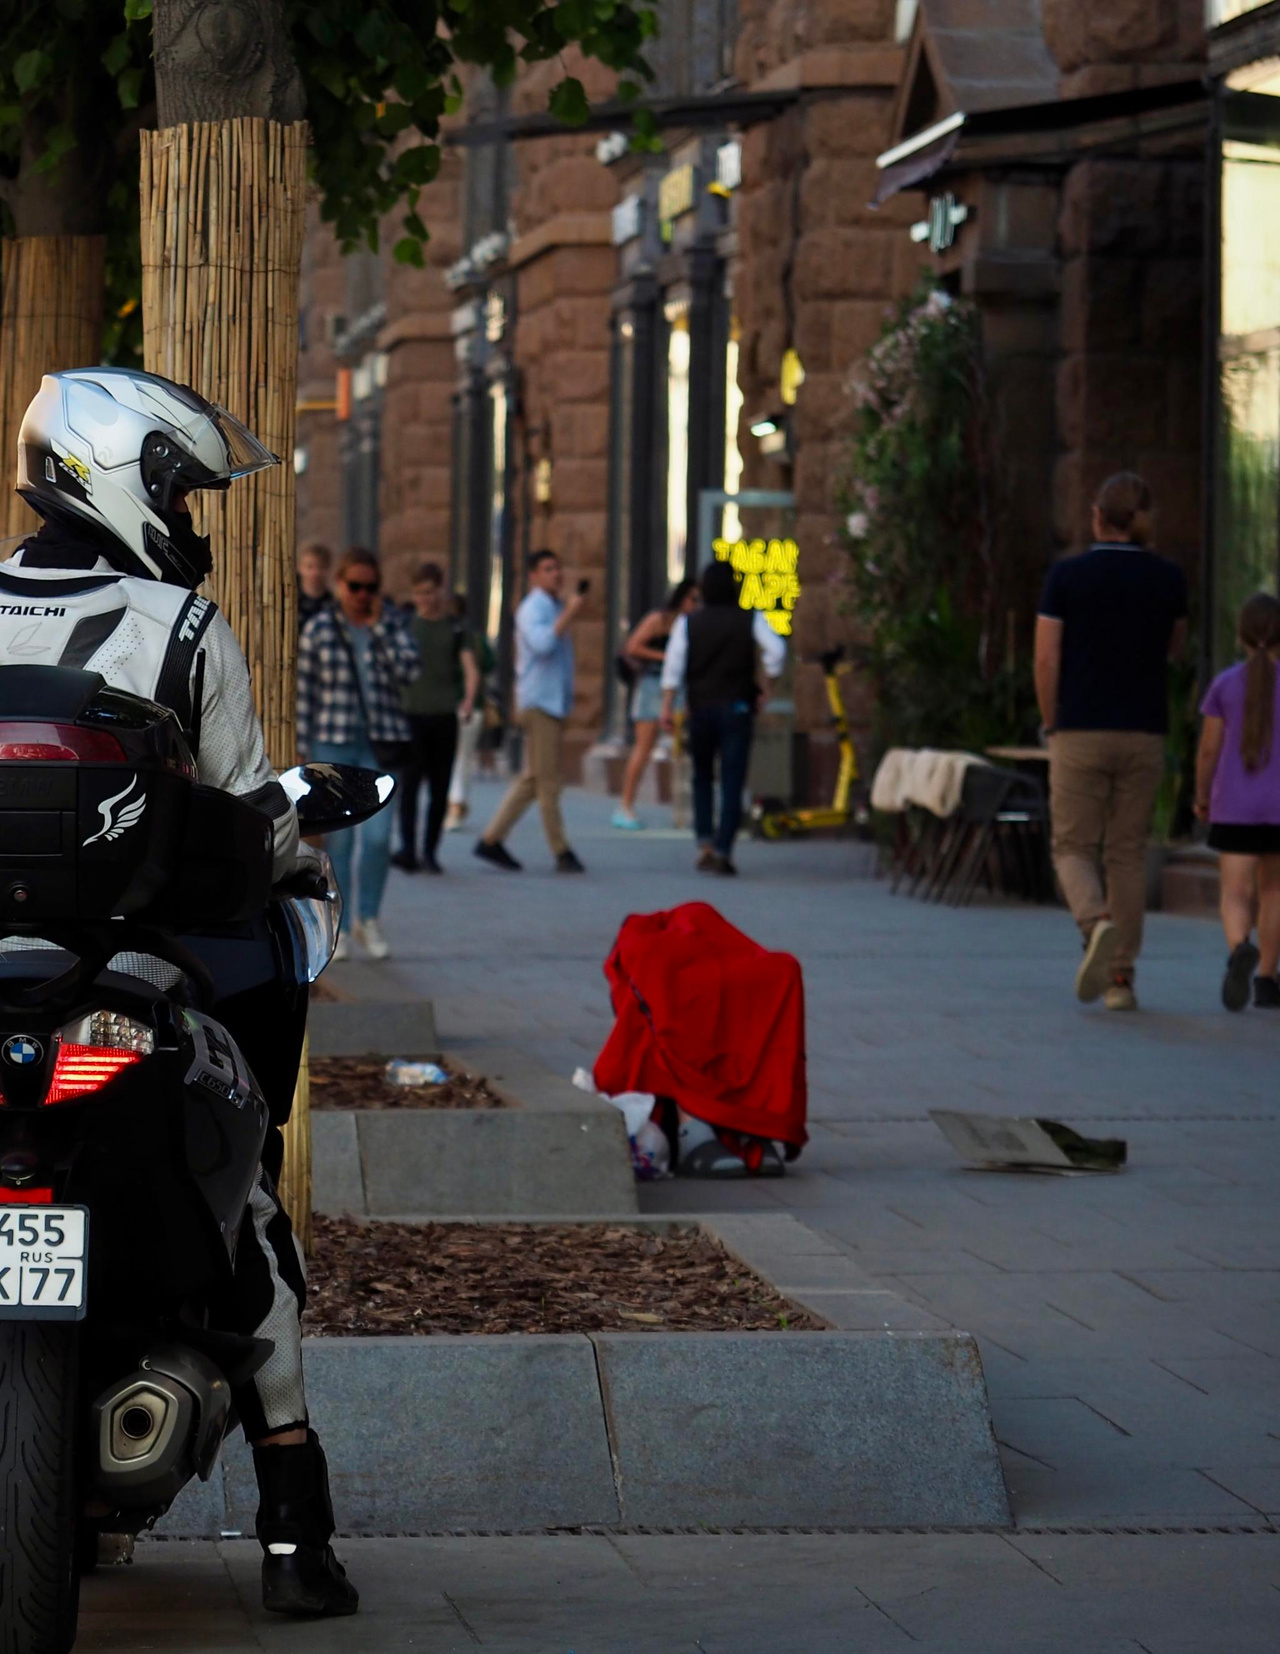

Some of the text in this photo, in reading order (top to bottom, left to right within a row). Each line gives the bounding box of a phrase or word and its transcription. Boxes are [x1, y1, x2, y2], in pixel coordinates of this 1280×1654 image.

[6, 1037, 39, 1049] BMW
[199, 1072, 231, 1097] C650
[20, 1252, 53, 1263] RUS
[29, 1268, 75, 1301] 77
